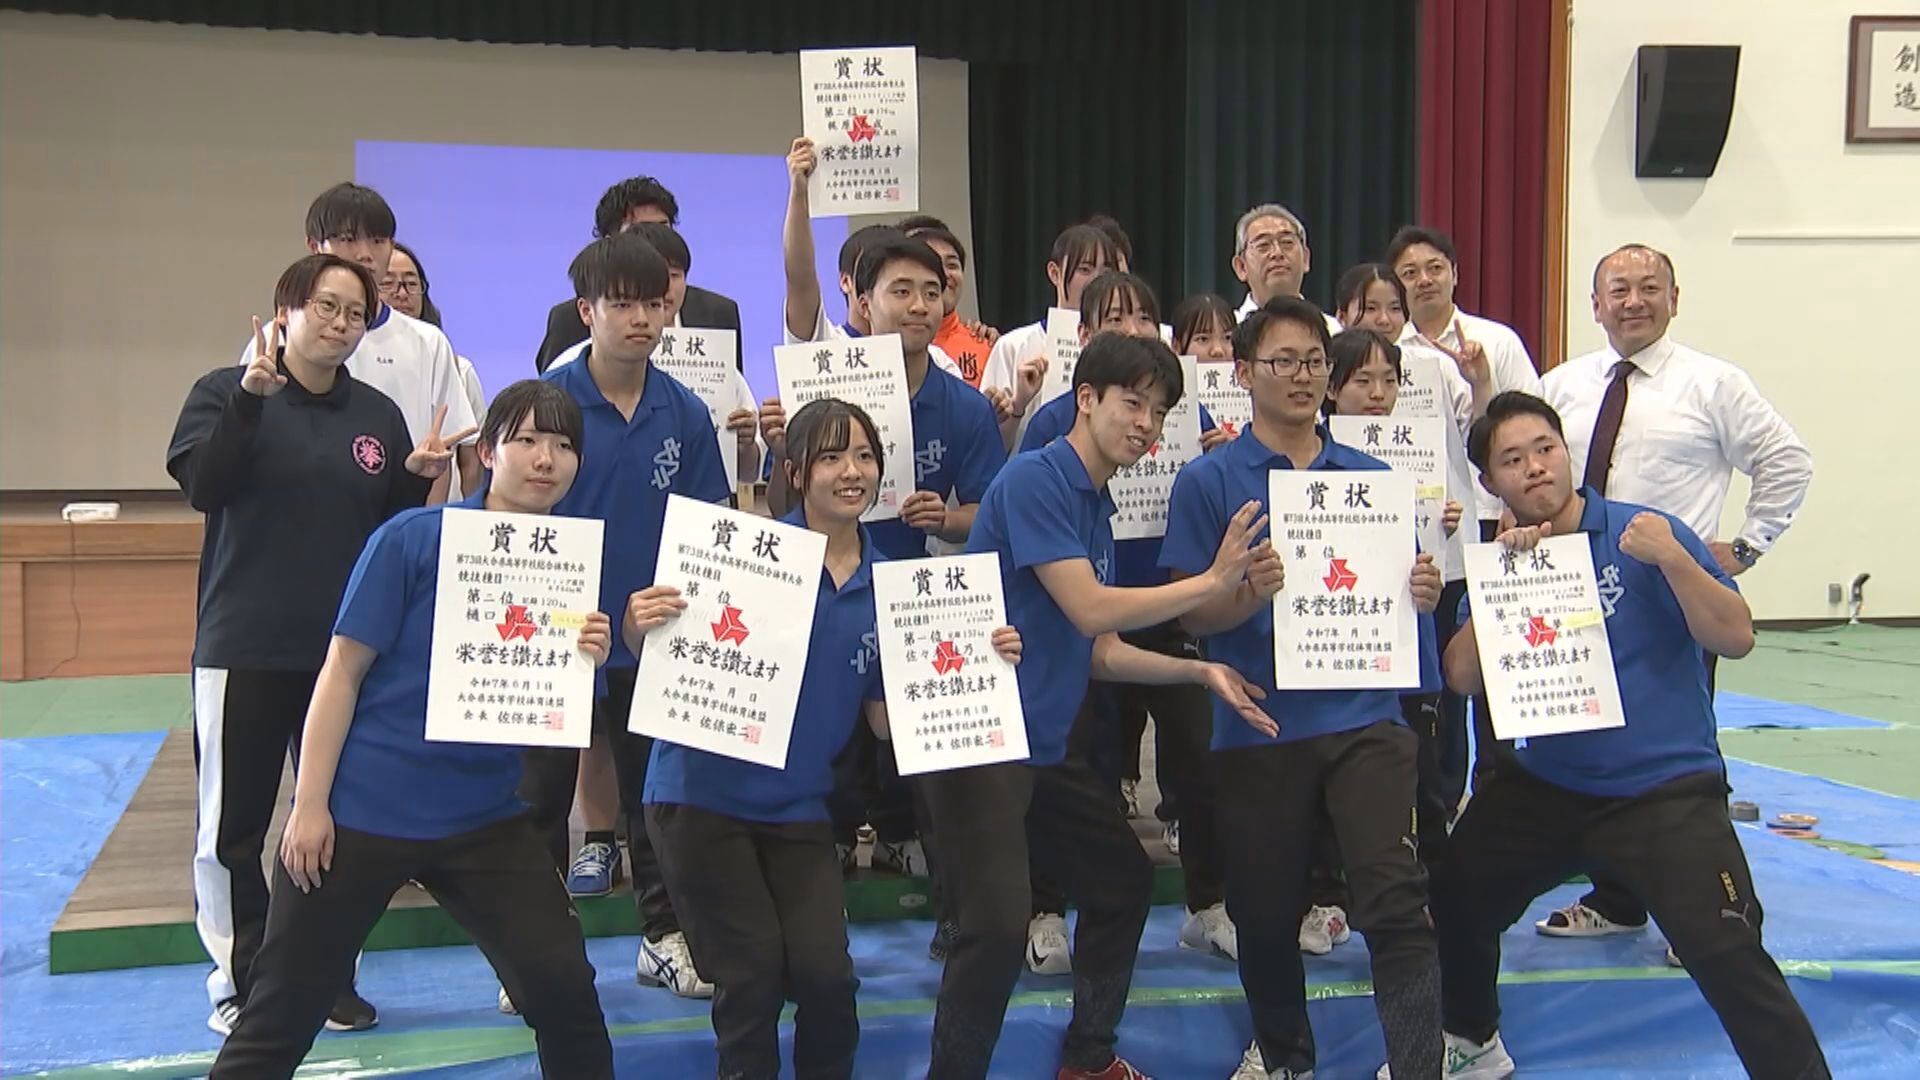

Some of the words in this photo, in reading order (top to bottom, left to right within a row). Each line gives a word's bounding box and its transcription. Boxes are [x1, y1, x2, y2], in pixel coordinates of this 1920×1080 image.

[834, 56, 885, 79] 賞状
[821, 144, 903, 161] 栄誉を讃えます
[659, 334, 706, 357] 賞状
[812, 346, 869, 375] 賞状
[1363, 423, 1414, 447] 賞状
[1305, 481, 1373, 510] 賞状
[489, 521, 559, 554] 賞状
[711, 518, 781, 562] 賞状
[1287, 528, 1323, 540] 競技種目
[679, 561, 722, 582] 競技種目
[1499, 549, 1556, 576] 賞状
[457, 571, 502, 585] 競技種目
[911, 566, 969, 597] 賞状
[1292, 595, 1394, 617] 栄誉を讃えます
[894, 614, 930, 629] 競技種目
[455, 642, 573, 668] 栄誉を讃えます
[668, 635, 781, 682] 栄誉を讃えます
[1499, 648, 1592, 672] 栄誉を讃えます
[904, 675, 998, 702] 栄誉を讃えます
